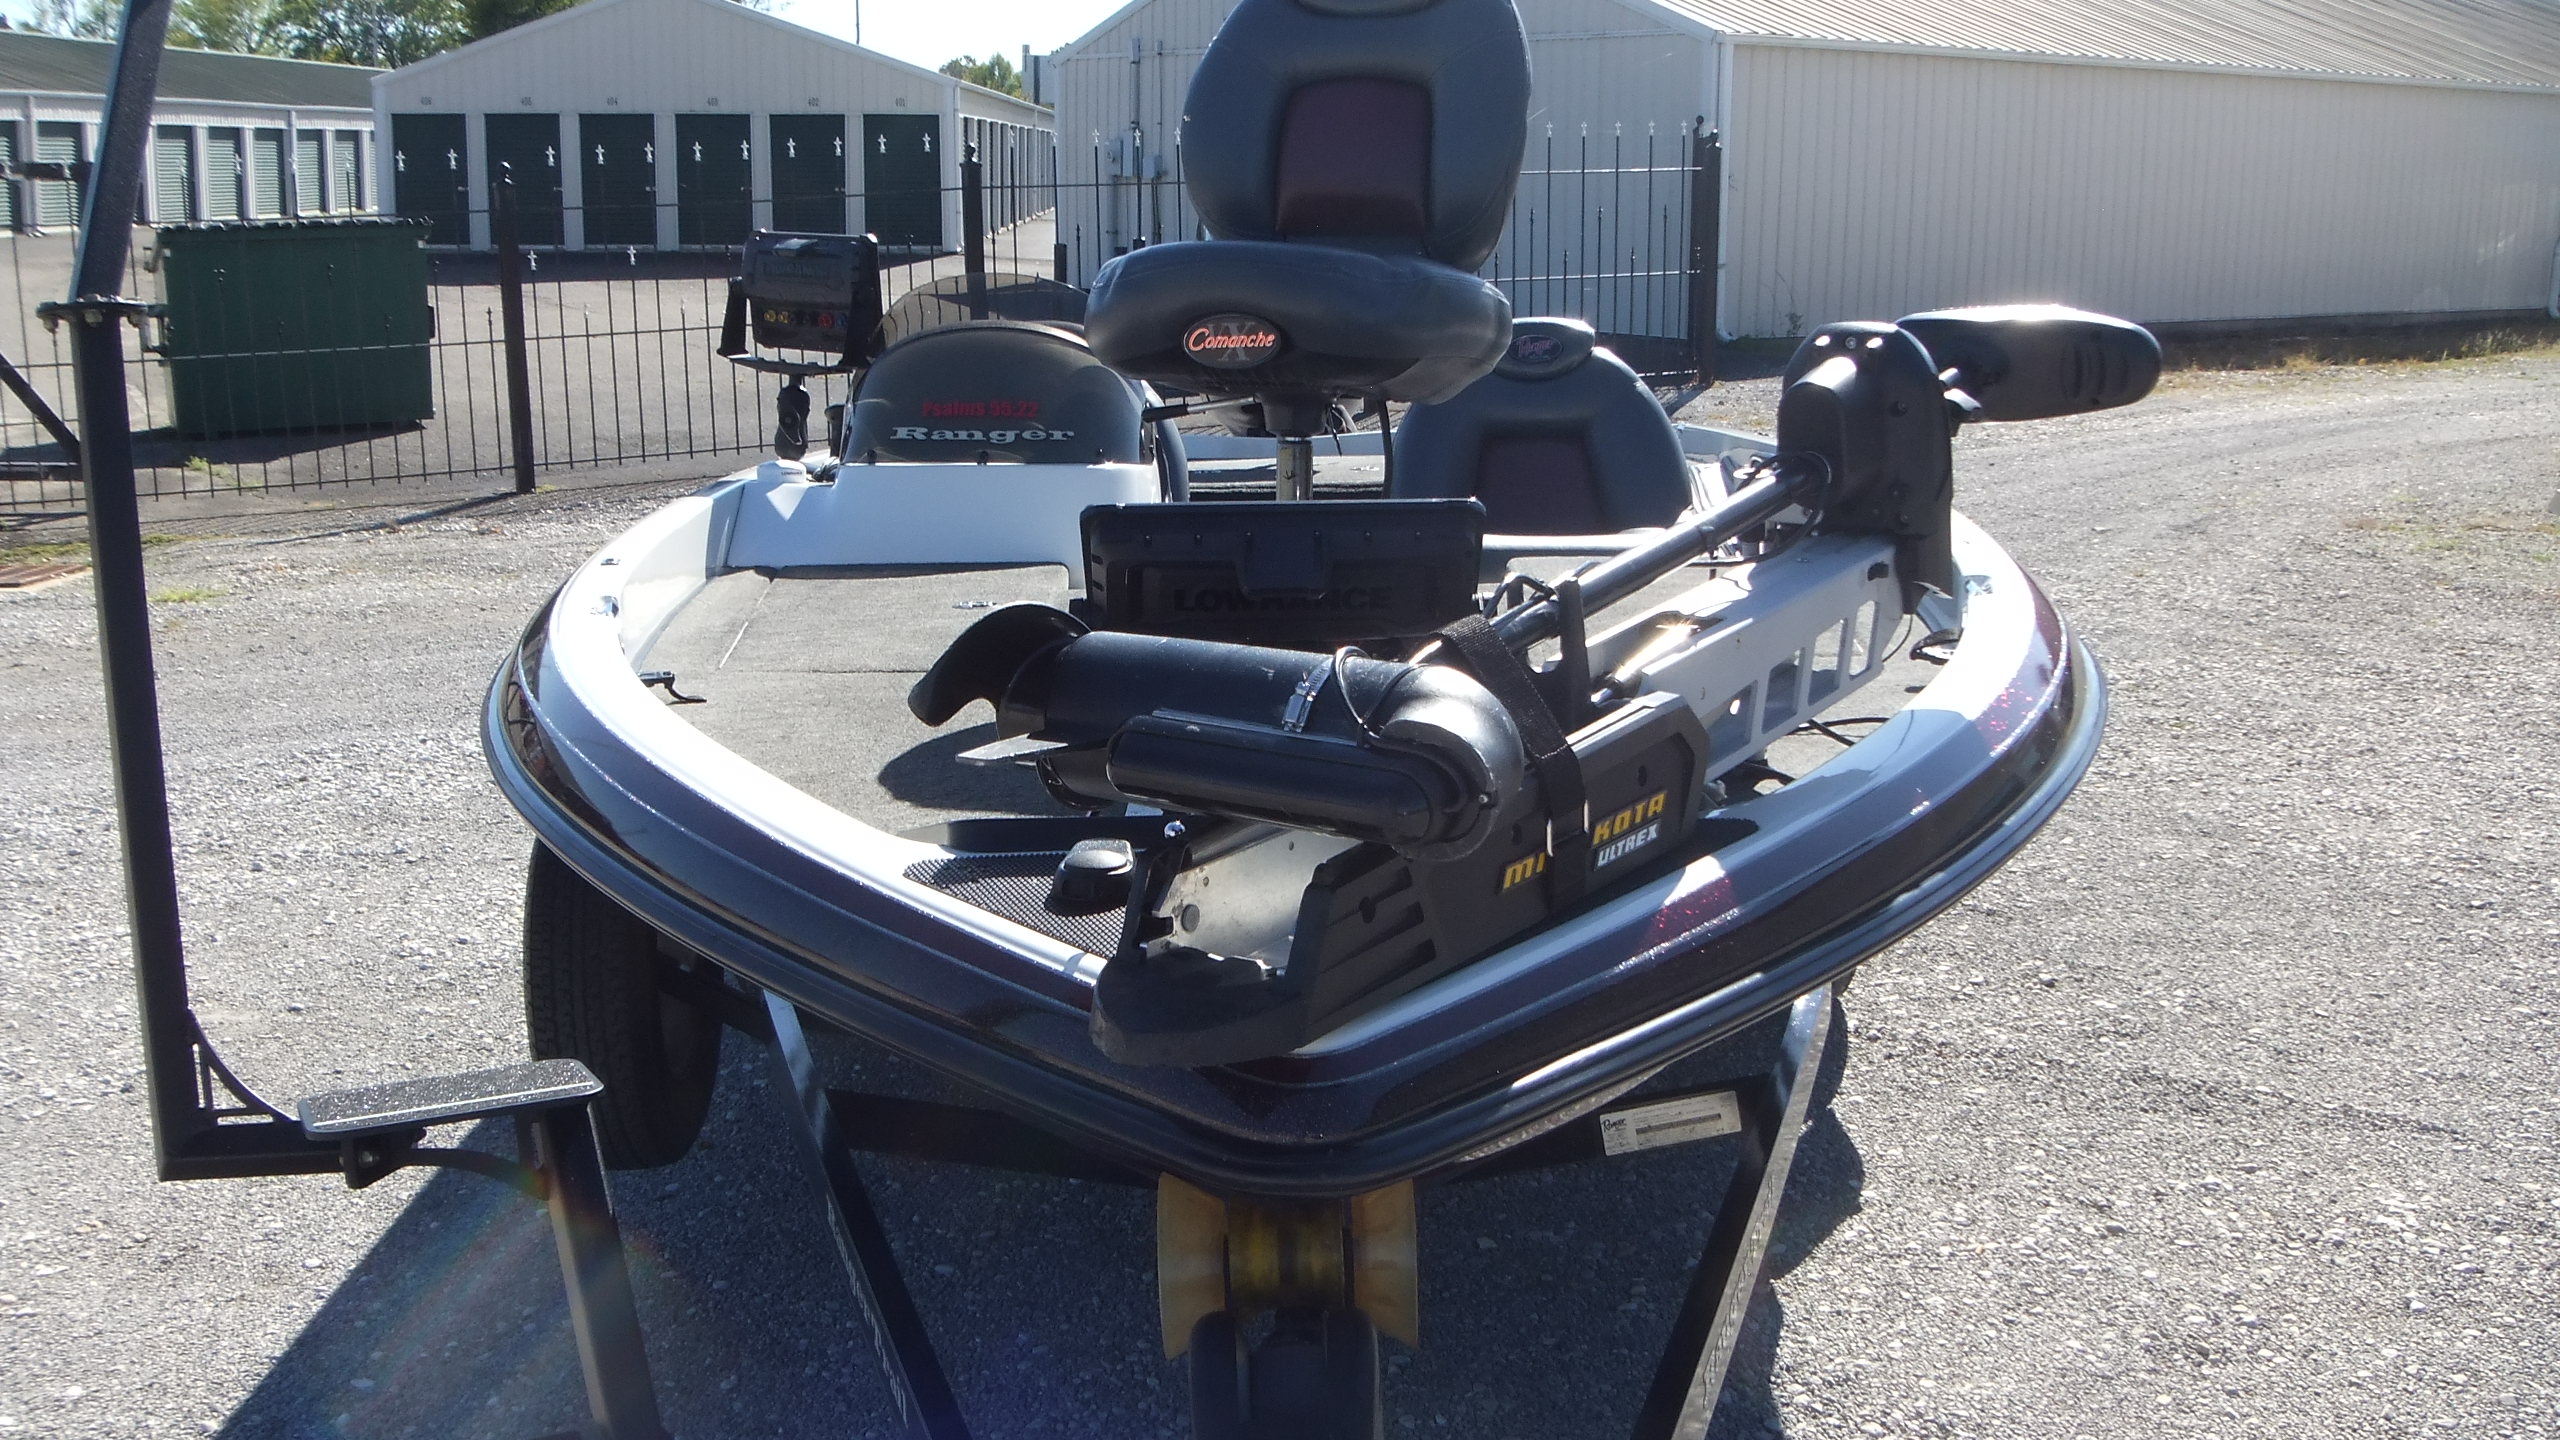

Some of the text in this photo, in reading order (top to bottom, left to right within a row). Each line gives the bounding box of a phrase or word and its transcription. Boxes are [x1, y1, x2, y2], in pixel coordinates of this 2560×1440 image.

[1188, 327, 1275, 352] Comanche
[923, 402, 985, 417] Psalms
[890, 426, 1074, 444] Ranger
[1593, 792, 1666, 847] KOTA
[1597, 822, 1660, 868] ULTREX
